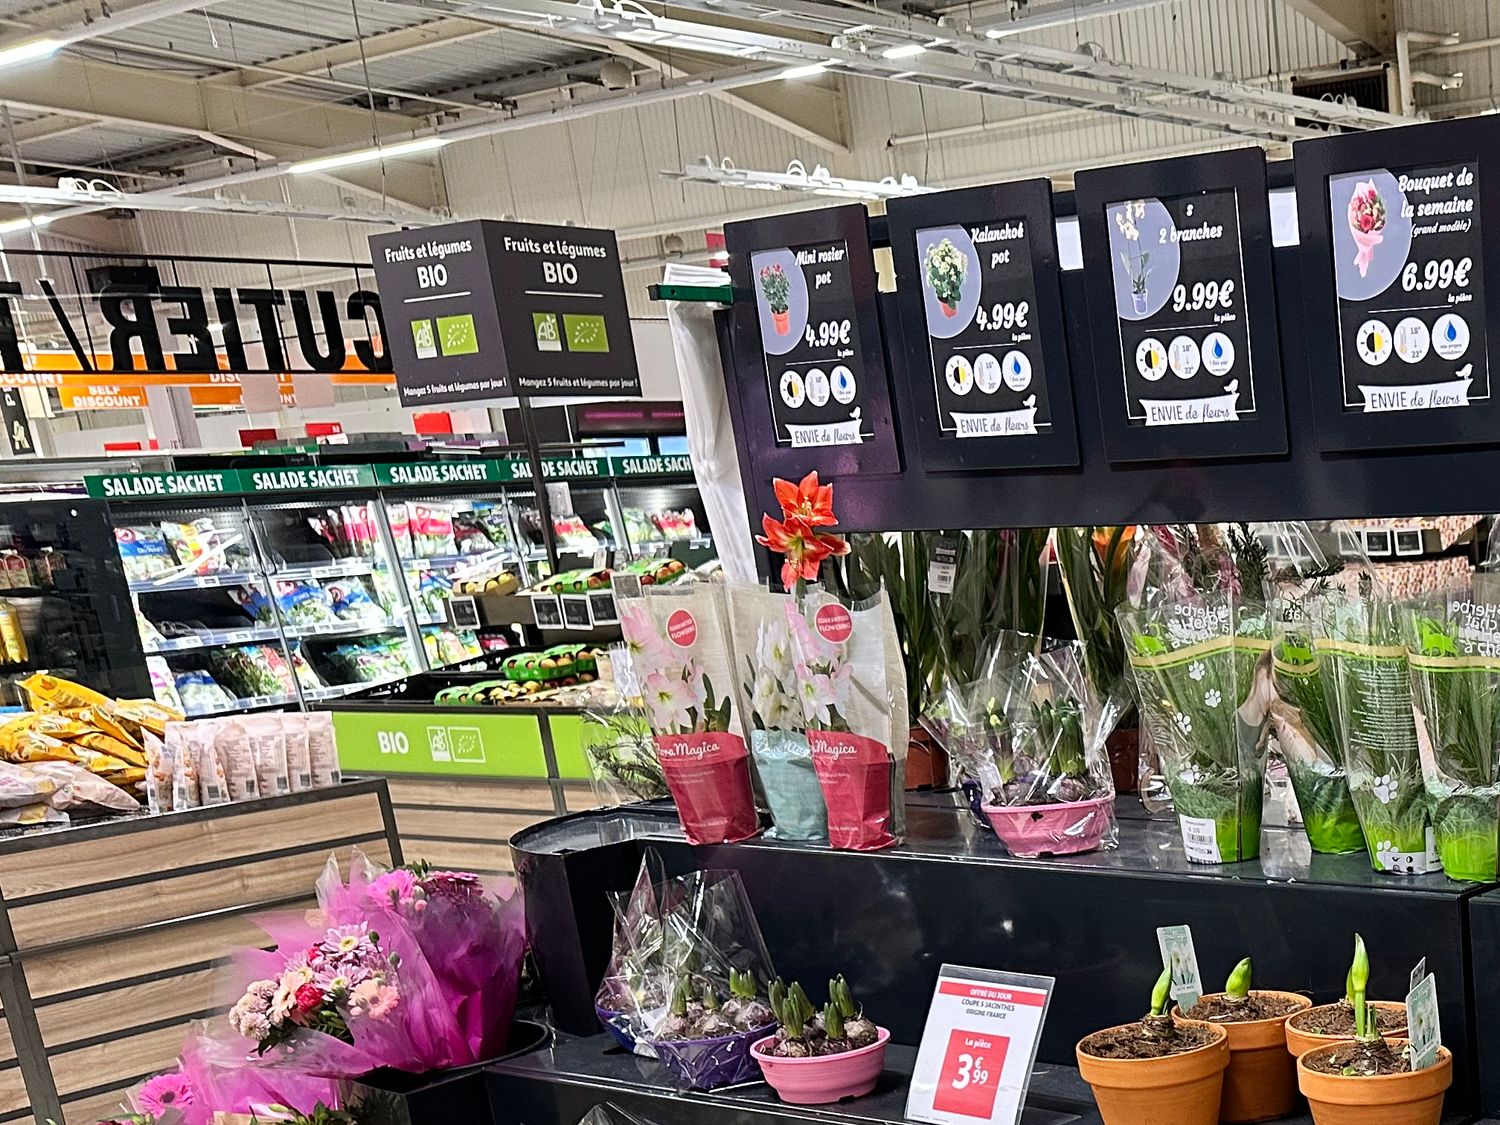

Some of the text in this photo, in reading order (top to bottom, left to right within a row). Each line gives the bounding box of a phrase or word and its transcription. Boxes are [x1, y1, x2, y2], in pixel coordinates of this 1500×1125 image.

[1399, 167, 1473, 195] Bouquet de
[1401, 196, 1473, 218] la semaine
[1159, 222, 1223, 244] 2 branches
[1410, 218, 1471, 238] (grand modèle)
[385, 239, 472, 262] Fruits et légumes
[504, 237, 606, 260] Fruits et légumes
[818, 247, 844, 263] rosier
[991, 249, 1010, 269] pot
[417, 264, 447, 288] BIO
[543, 261, 578, 285] BIO
[815, 271, 831, 289] pot
[1402, 257, 1473, 292] 6.99€
[1173, 280, 1234, 312] 9.99€
[976, 301, 1029, 331] 4.99€
[805, 319, 851, 347] 4.99€
[403, 385, 426, 397] Mangez
[519, 377, 547, 391] Mangez
[73, 396, 141, 407] DISCOUNT
[1371, 389, 1460, 408] ENVIE de fleurs
[1151, 403, 1230, 422] ENVIE de fleurs
[961, 418, 988, 433] ENVIE
[794, 429, 821, 444] ENVIE
[390, 464, 487, 483] SALADE SACHET
[511, 460, 598, 478] SALDE SACHET
[622, 457, 664, 474] SALADE
[102, 473, 223, 497] SALADE SACHET
[253, 469, 359, 490] SALADE SACHET
[377, 731, 409, 754] BIO
[961, 998, 979, 1008] COUPE
[985, 1001, 1015, 1012] JACINTHES
[986, 1010, 1006, 1019] FRANCE
[965, 1037, 991, 1049] La pièce
[951, 1053, 974, 1090] 3
[972, 1069, 988, 1085] 99
